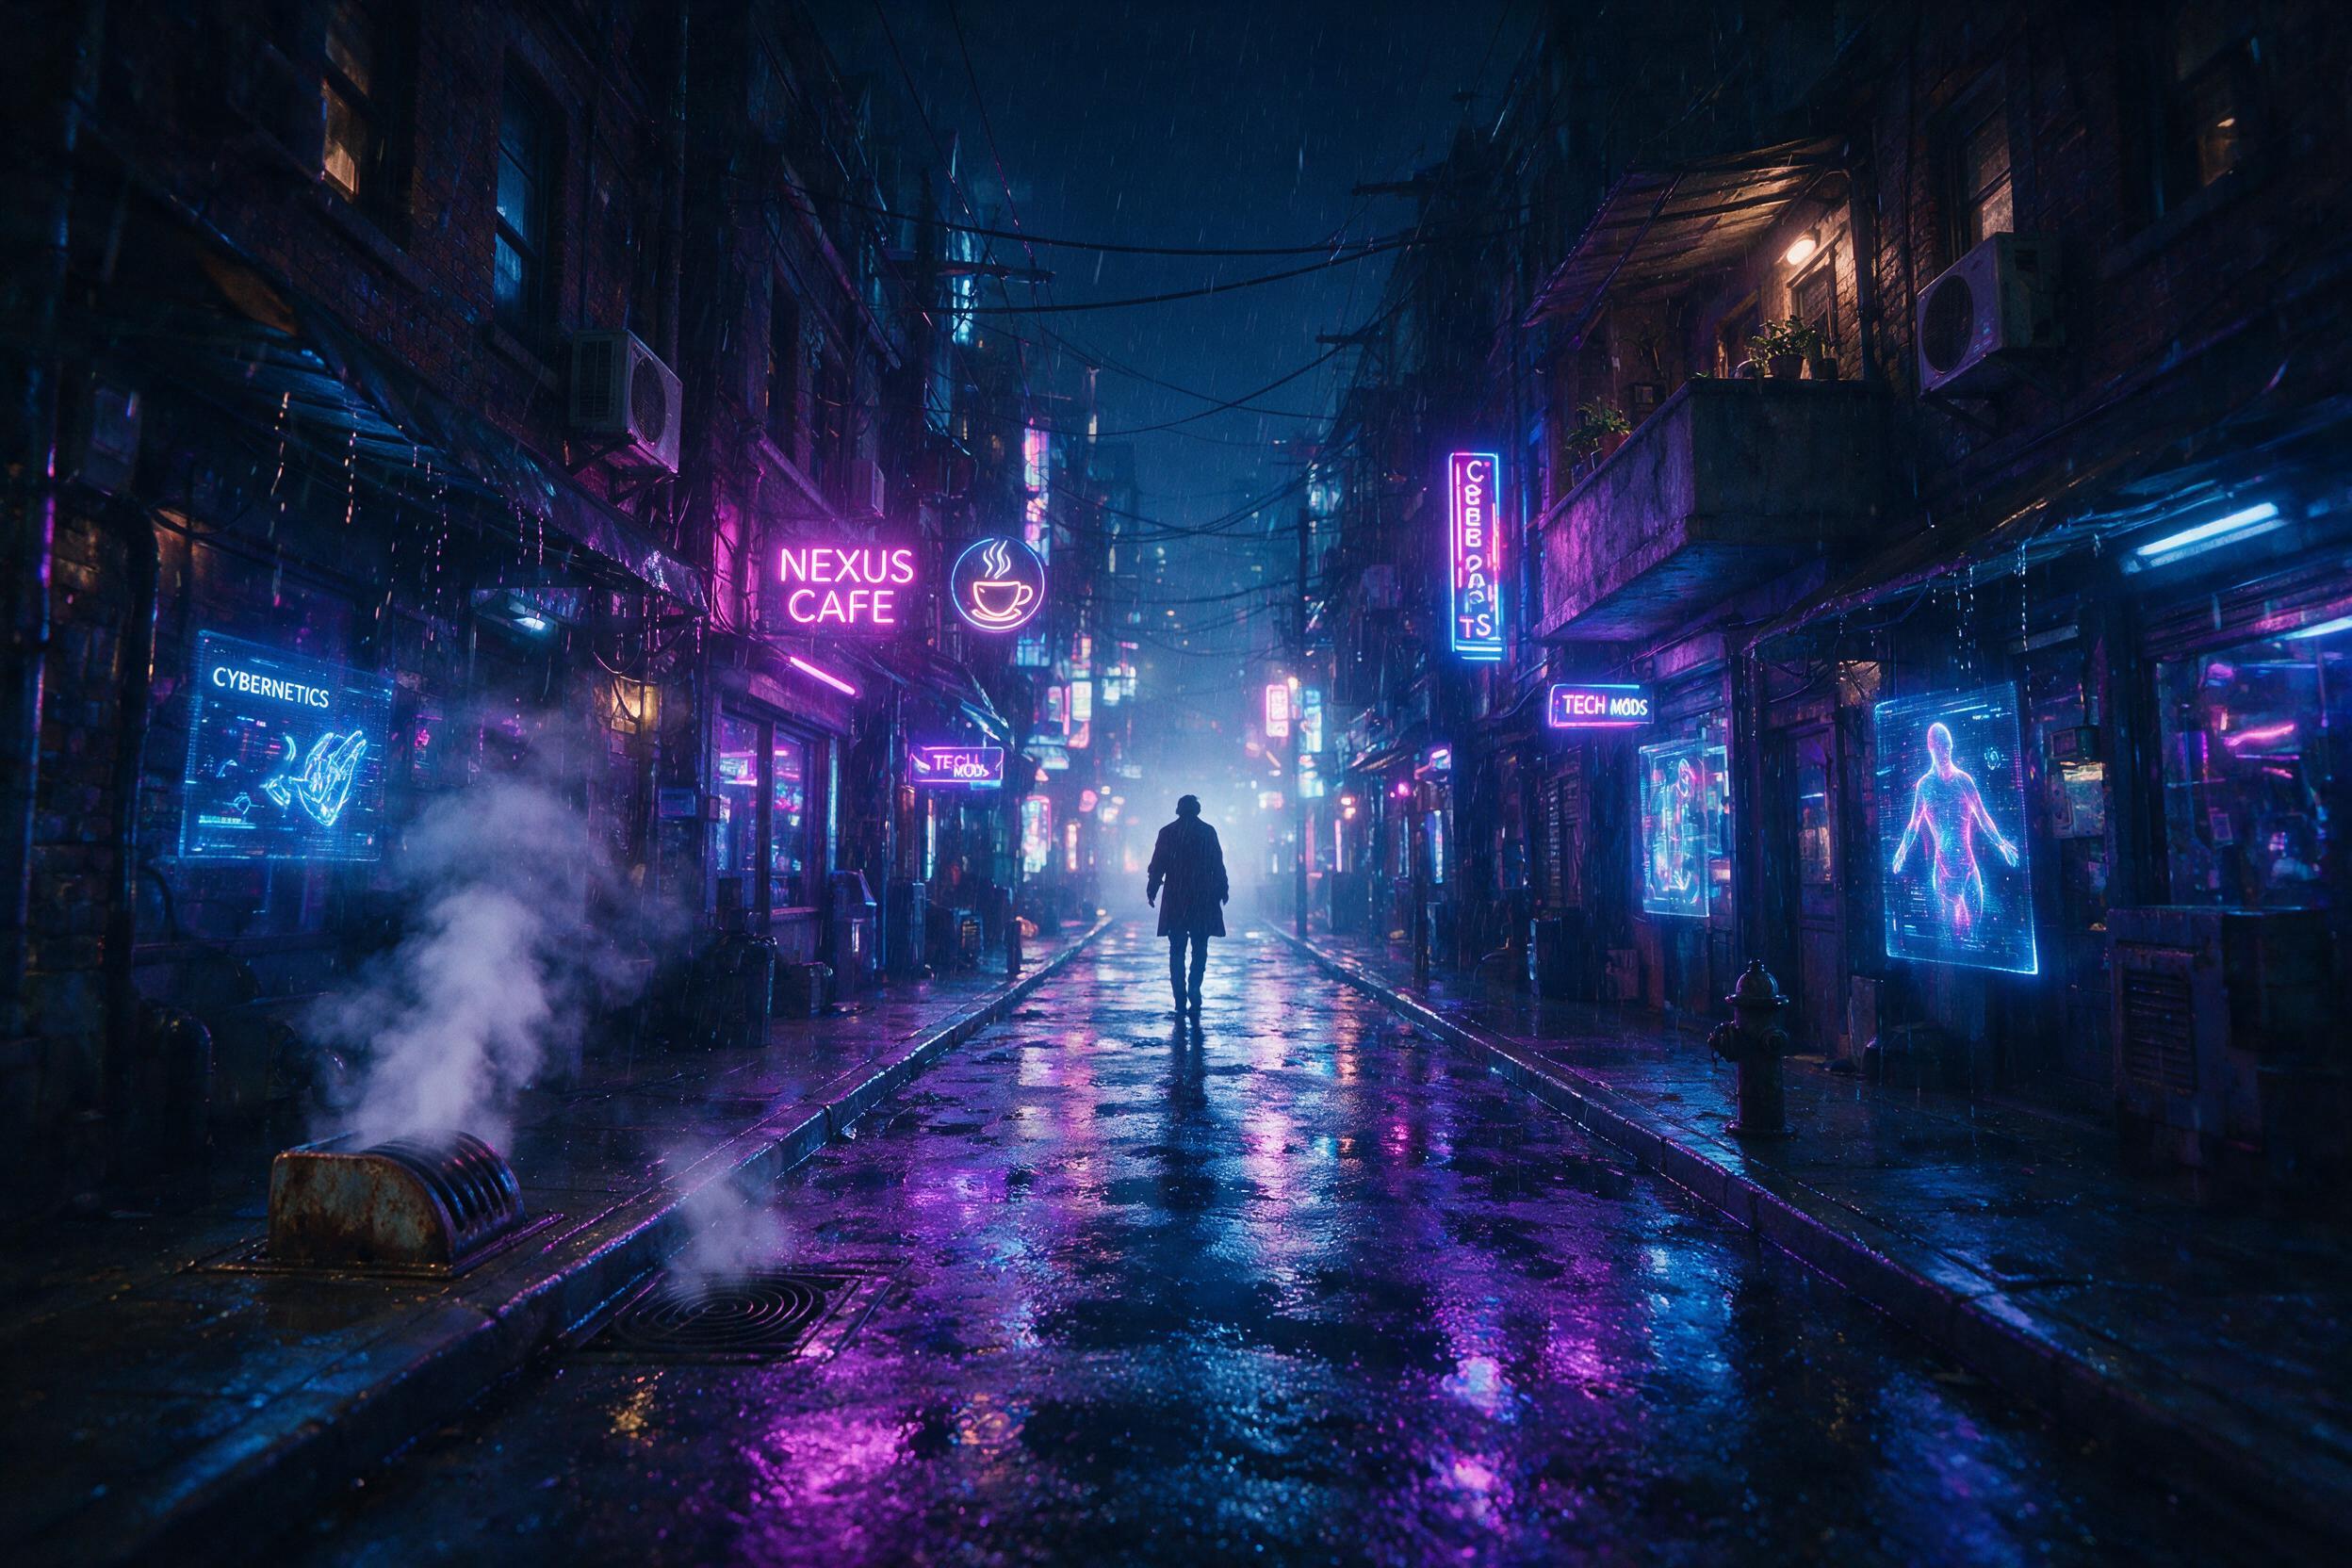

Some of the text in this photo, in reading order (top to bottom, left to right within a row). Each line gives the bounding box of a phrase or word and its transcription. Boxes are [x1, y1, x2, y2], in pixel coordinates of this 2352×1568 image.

[780, 548, 913, 583] NEXUS
[789, 589, 894, 623] CAFE
[213, 667, 329, 708] CYBERNETICS
[1562, 694, 1648, 716] TECH MODS
